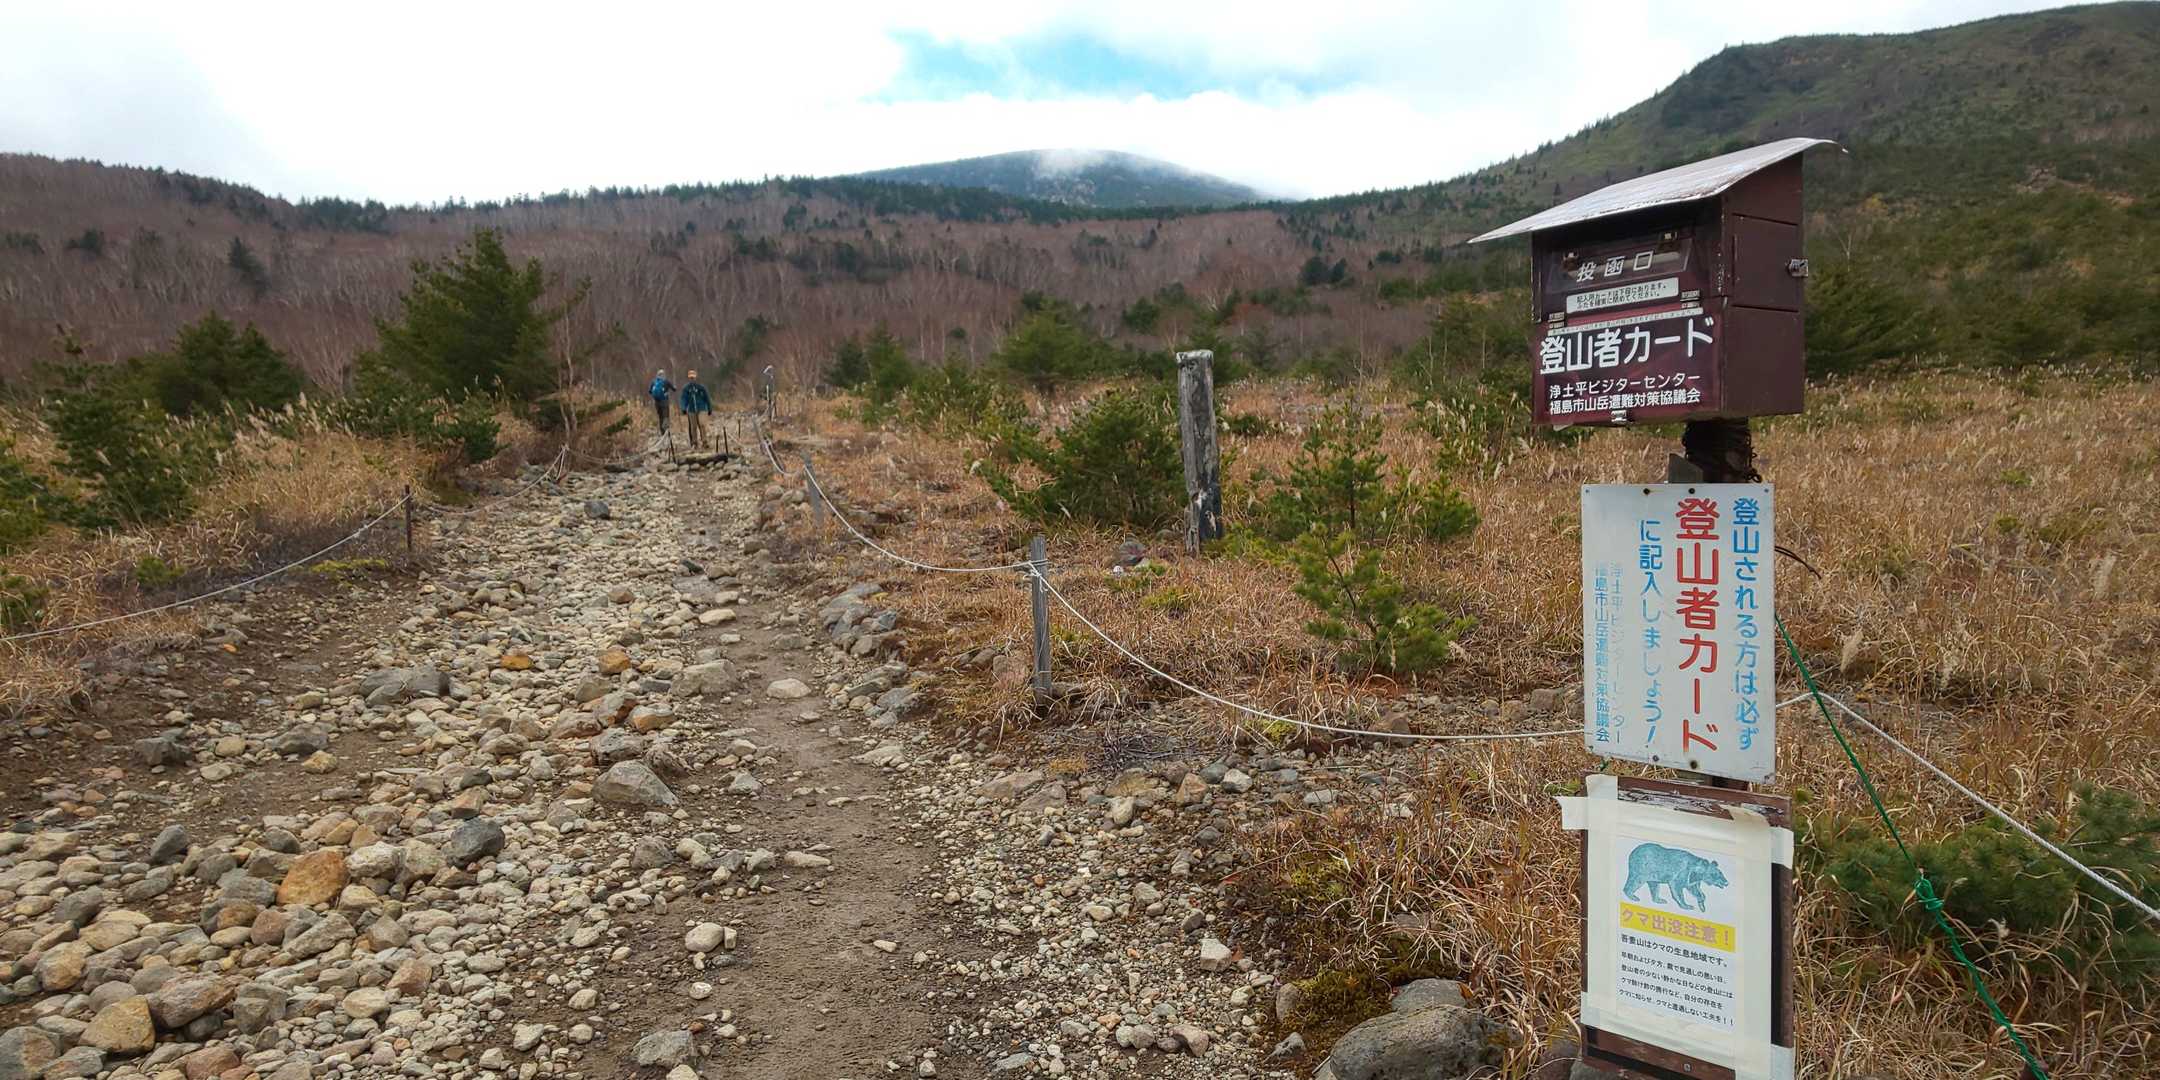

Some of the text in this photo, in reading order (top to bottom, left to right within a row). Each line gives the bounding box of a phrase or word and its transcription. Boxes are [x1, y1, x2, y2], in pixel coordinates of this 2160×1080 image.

[1576, 251, 1654, 283] 投函口
[1539, 316, 1715, 375] 登山者カード
[1550, 373, 1700, 398] 浄土平ビジターセンター
[1550, 388, 1700, 415] 福島市山岳遭難対策協議会
[1675, 497, 1720, 752] 登山者カード
[1732, 498, 1761, 750] 登山される方は必ず
[1622, 908, 1729, 945] クマ出没注意！
[1621, 934, 1727, 967] 吾妻山はクマの生息地域です。
